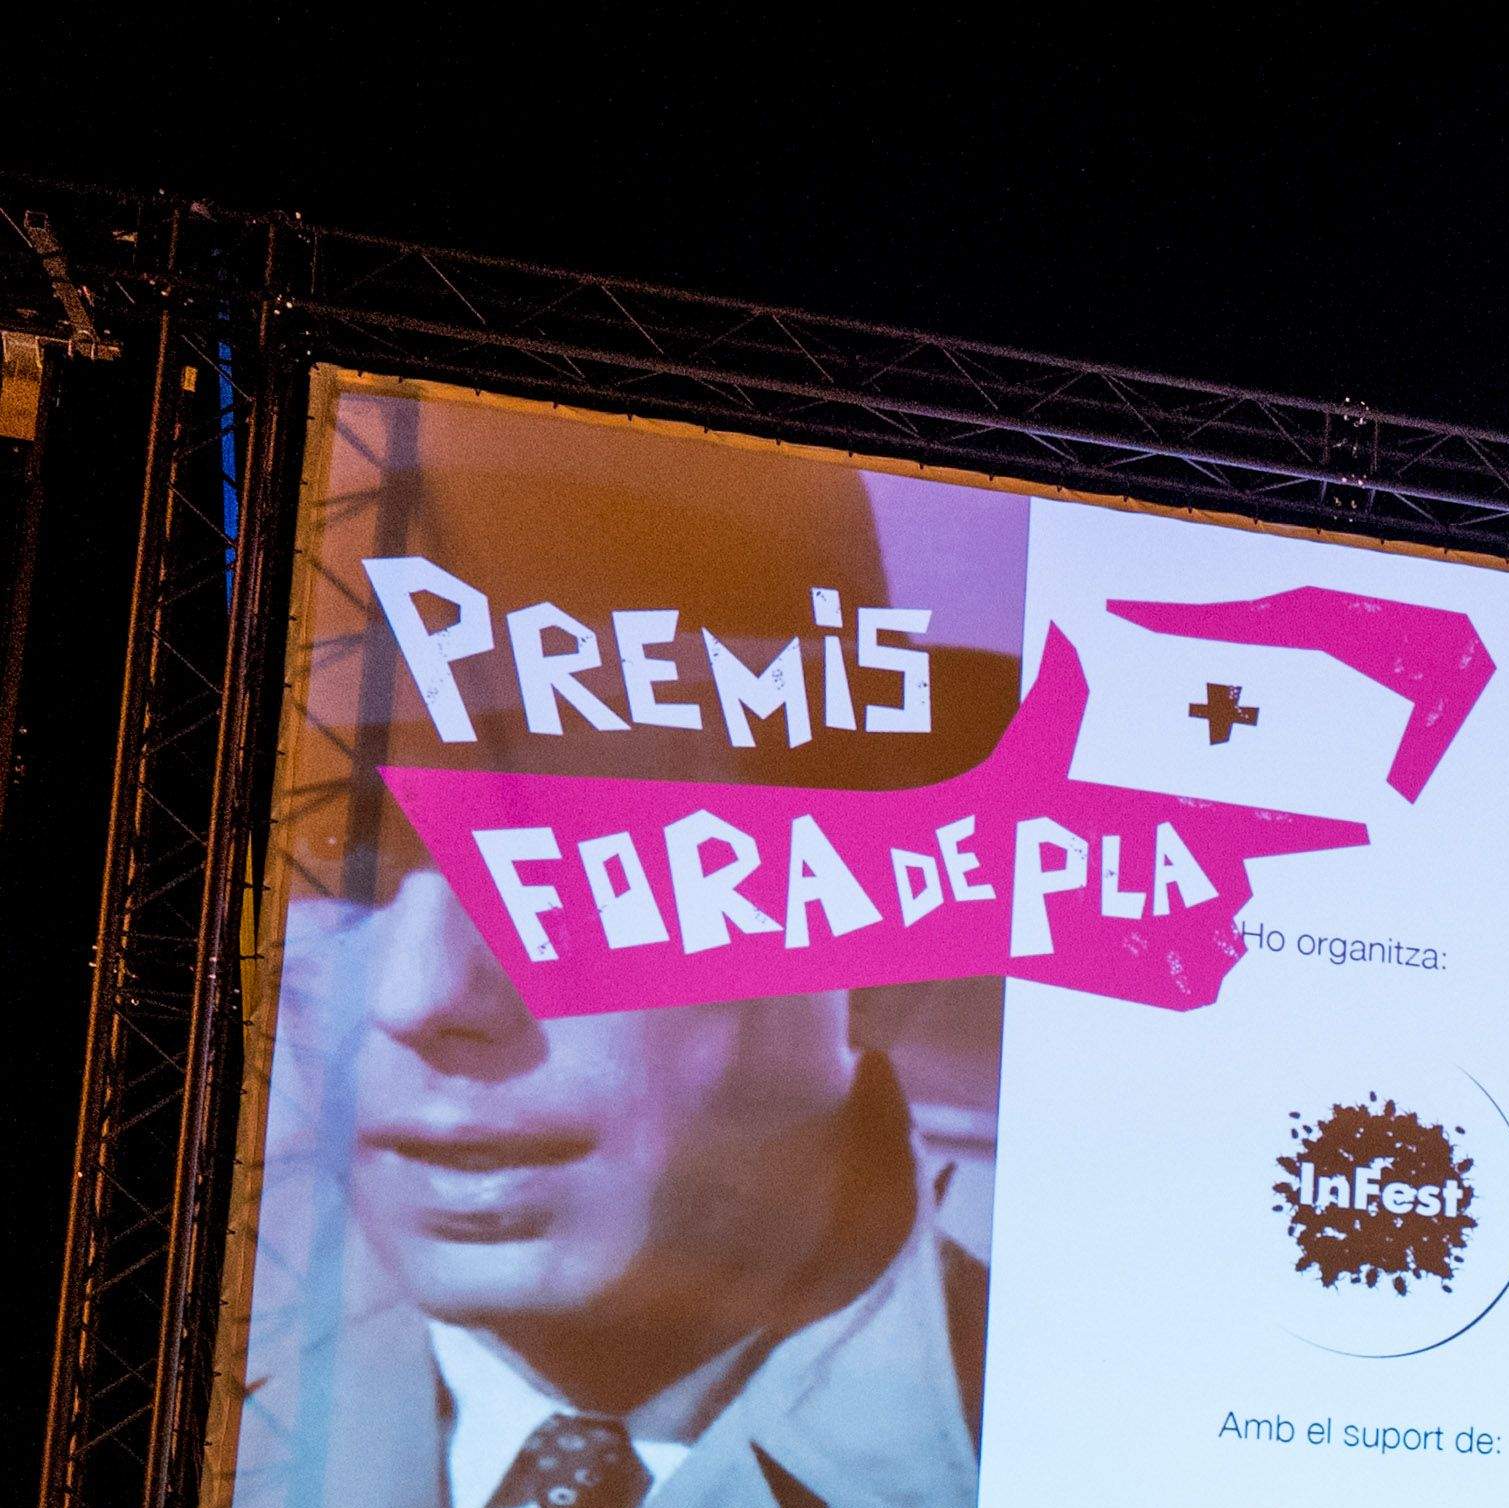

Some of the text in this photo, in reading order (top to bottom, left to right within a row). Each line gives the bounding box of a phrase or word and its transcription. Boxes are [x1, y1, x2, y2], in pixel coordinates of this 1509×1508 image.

[471, 807, 1219, 963] FORA DE PLA
[1241, 920, 1447, 970] Ho organitza:
[1218, 1410, 1502, 1456] Amb el suport de:
